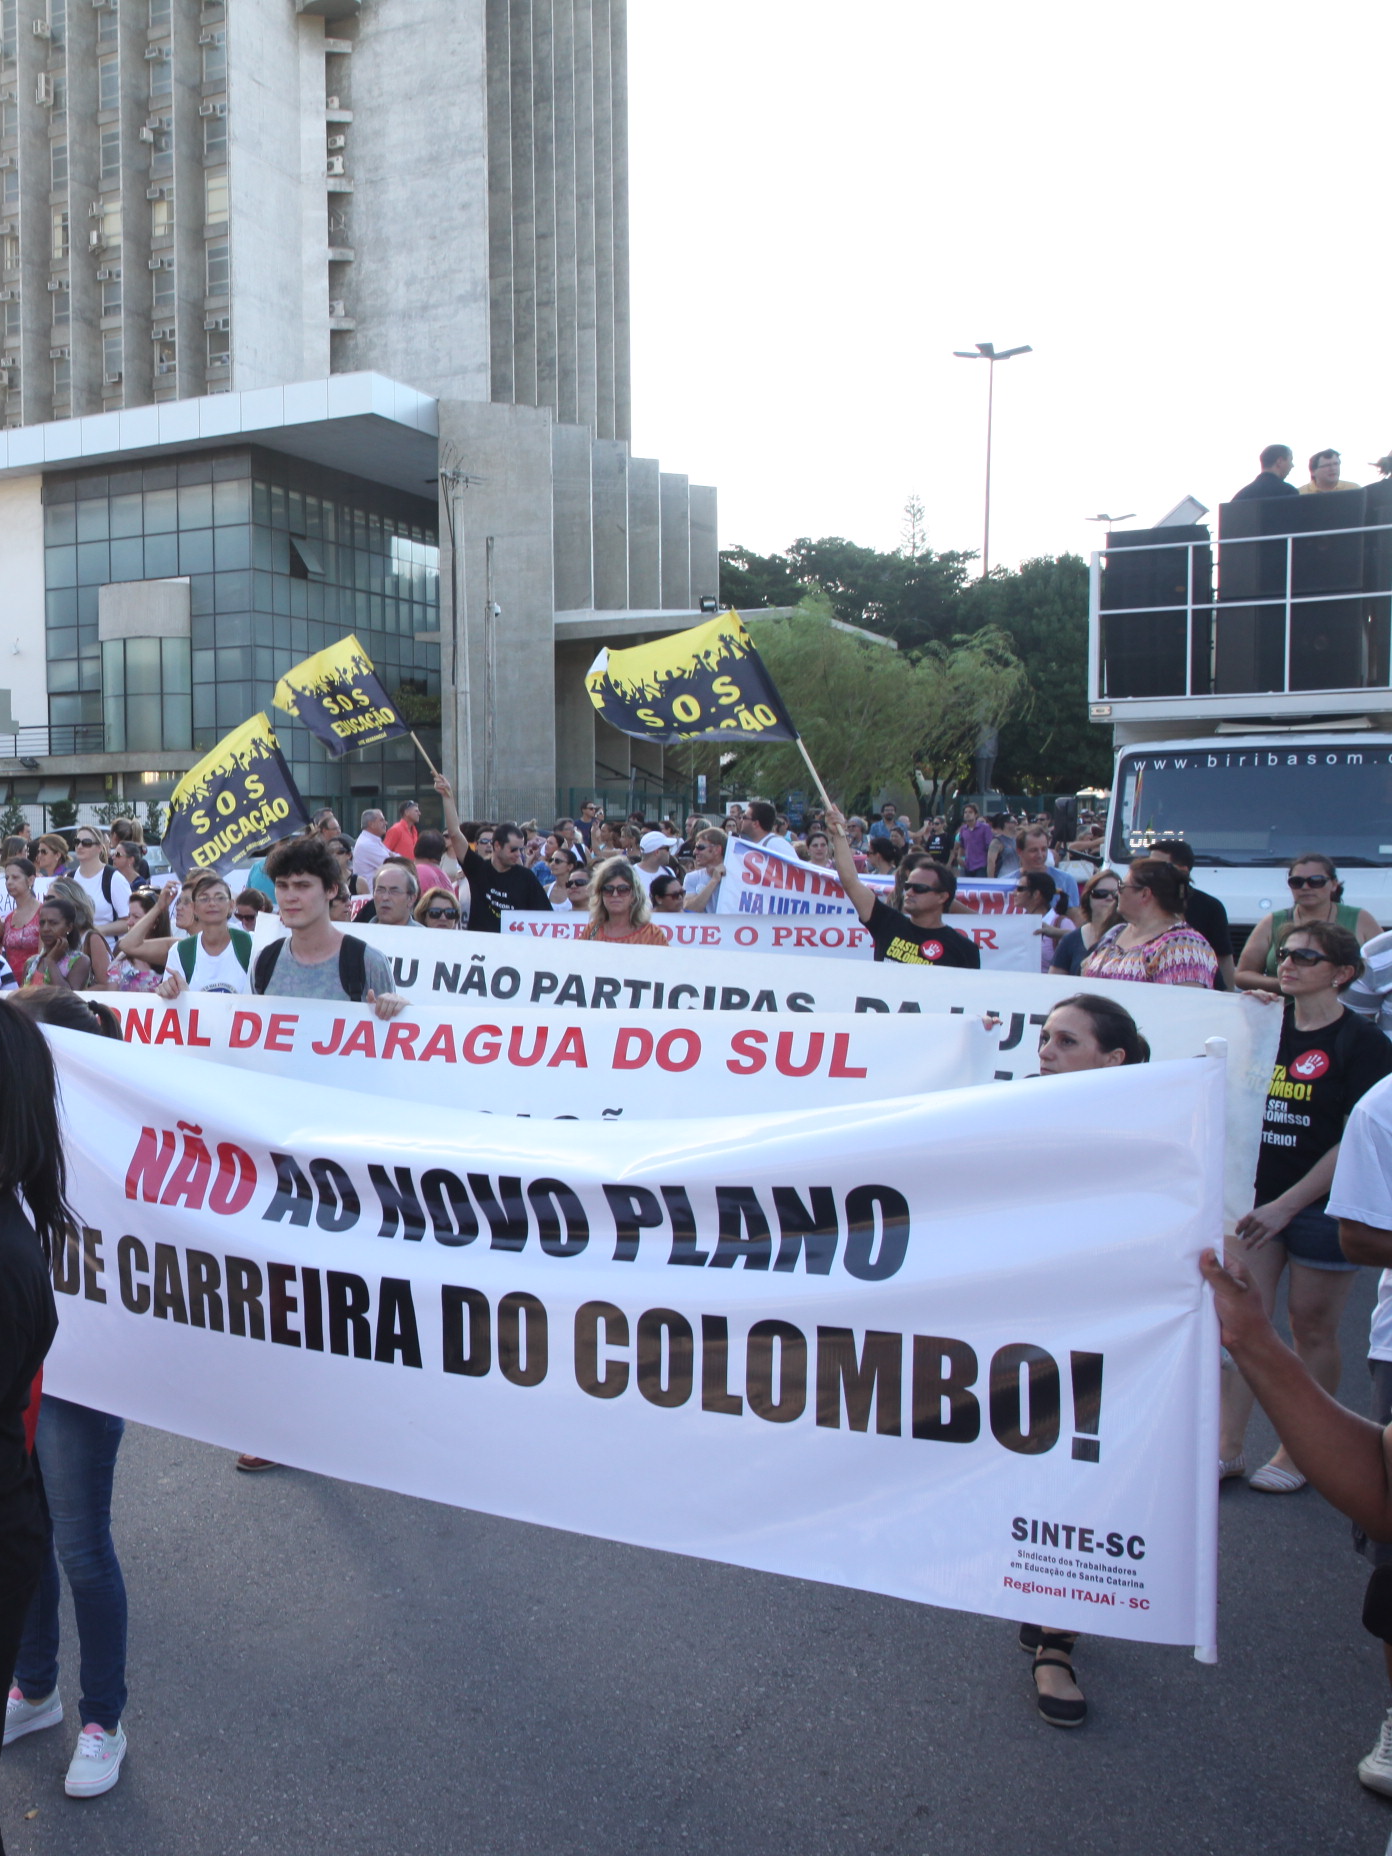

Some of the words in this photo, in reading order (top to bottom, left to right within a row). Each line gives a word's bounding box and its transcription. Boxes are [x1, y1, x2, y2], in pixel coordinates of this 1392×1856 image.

[330, 707, 396, 738] EDUCAÇÃO
[192, 797, 290, 867] EDUCAÇÃO
[742, 850, 845, 899] SANTA
[739, 891, 764, 914] NA
[734, 926, 759, 946] O
[891, 936, 920, 956] BASTA
[387, 957, 419, 988] U
[432, 954, 521, 1000] NÃO
[229, 1011, 299, 1052] DE
[311, 1017, 590, 1069] JARAGUA
[611, 1027, 702, 1072] DO
[725, 1031, 868, 1079] SUL
[1262, 1130, 1297, 1147] TÉRIO!
[125, 1120, 258, 1215] NÃO
[262, 1151, 362, 1233] AO
[367, 1163, 590, 1258] NOVO
[601, 1184, 911, 1282] PLANO
[52, 1222, 107, 1304] DE
[117, 1235, 423, 1369] CARREIRA
[441, 1284, 549, 1387] DO
[574, 1300, 1105, 1463] COLOMBO!
[1011, 1516, 1146, 1561] SINTE-SC
[1010, 1561, 1023, 1569] em
[1024, 1563, 1065, 1577] Educação
[1066, 1570, 1077, 1579] de
[1079, 1572, 1104, 1583] Santa
[1106, 1576, 1145, 1589] Catarina
[1017, 1549, 1057, 1564] Sindicato
[1058, 1556, 1074, 1567] dos
[1075, 1559, 1137, 1576] Trabalhadores
[1003, 1576, 1067, 1598] Regional
[1071, 1588, 1116, 1606] ITAJAÍ
[1128, 1597, 1151, 1610] SC
